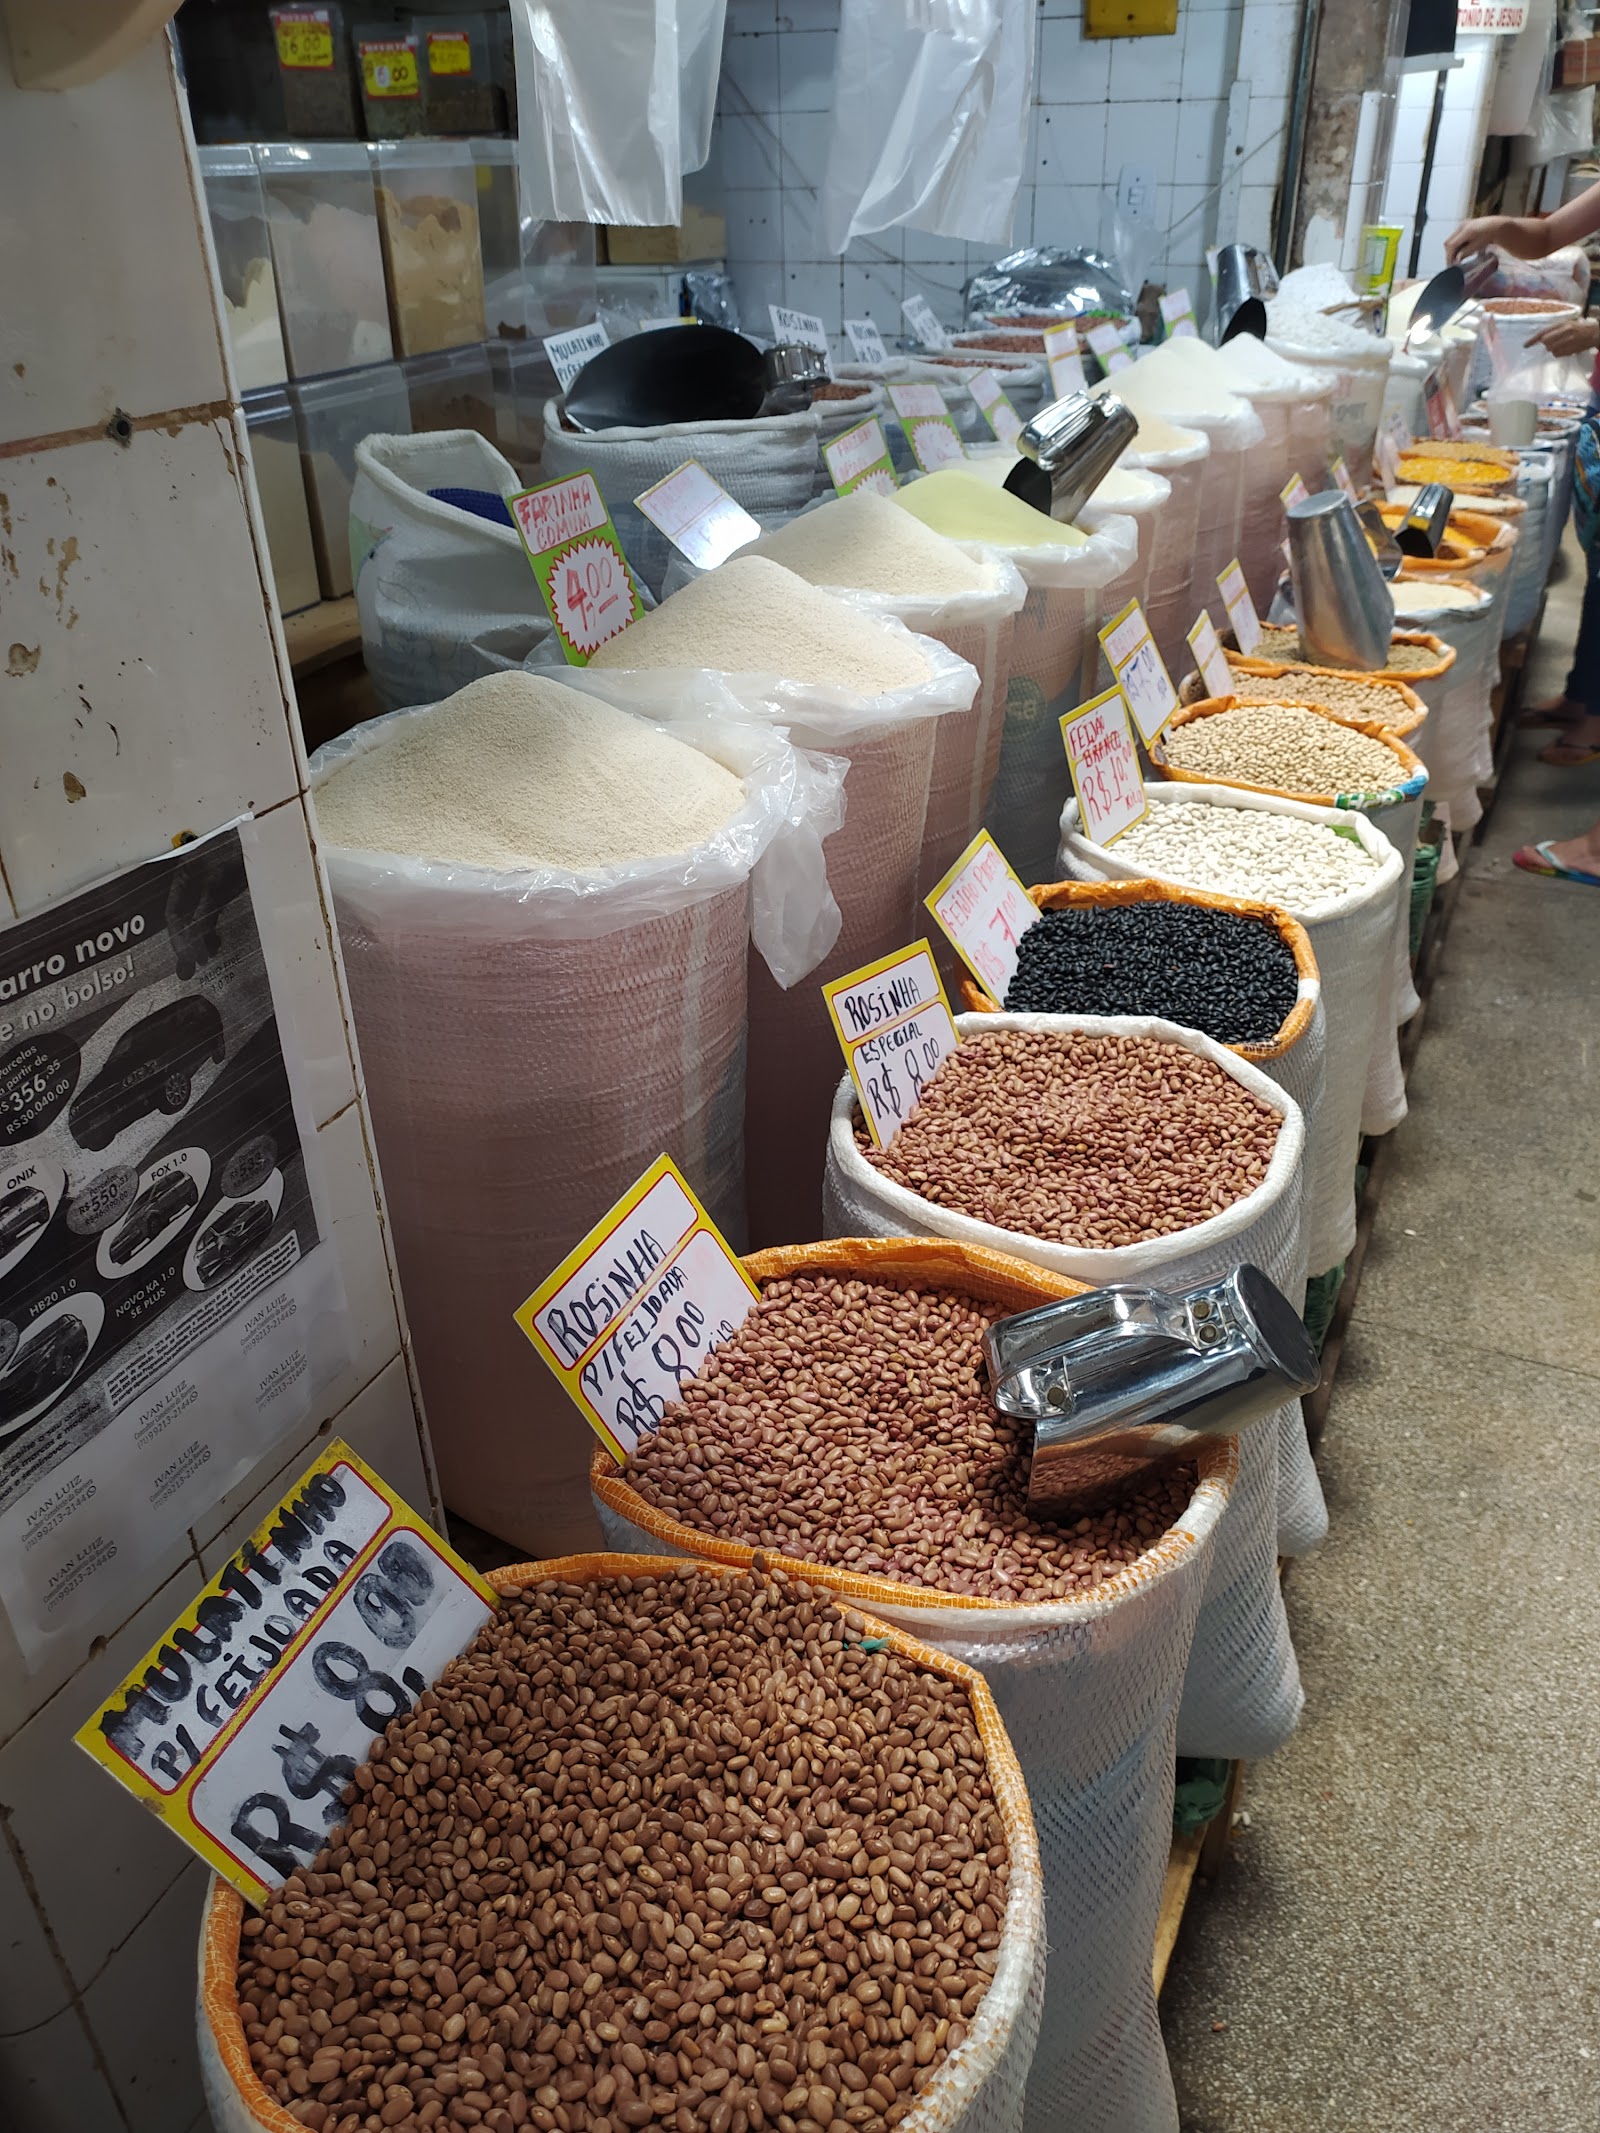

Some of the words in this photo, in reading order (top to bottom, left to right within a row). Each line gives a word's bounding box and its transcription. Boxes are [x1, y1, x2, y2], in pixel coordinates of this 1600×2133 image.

[1484, 8, 1495, 26] DE
[1496, 8, 1523, 27] JESUS
[517, 479, 592, 535] FARINHA
[536, 513, 592, 551] COMUM
[1082, 765, 1113, 823] R$
[75, 914, 145, 963] novo
[972, 939, 1006, 986] R$
[21, 1002, 56, 1030] no
[61, 954, 135, 1010] bolso!
[844, 974, 922, 1034] ROSINHA
[860, 1020, 924, 1065] ESPECIAL
[6, 1063, 32, 1091] partir
[34, 1053, 49, 1067] de
[866, 1061, 903, 1121] R$
[7, 1165, 37, 1190] ONIX
[150, 1162, 171, 1182] FOX
[173, 1152, 188, 1168] 1.0
[28, 1292, 59, 1318] HB20
[60, 1278, 77, 1296] 1.0
[115, 1290, 145, 1318] NOVO
[146, 1278, 160, 1293] KA
[161, 1266, 176, 1282] 1.0
[130, 1303, 143, 1319] SE
[143, 1287, 167, 1309] PLUS
[244, 1310, 264, 1332] IVAN
[265, 1293, 288, 1314] LUIZ
[547, 1228, 668, 1363] ROSINHA
[259, 1368, 280, 1391] IVAN
[280, 1349, 301, 1371] LUIZ
[139, 1400, 164, 1425] IVAN
[165, 1380, 188, 1403] LUIZ
[615, 1369, 666, 1438] R$
[153, 1462, 177, 1488] IVAN
[178, 1440, 201, 1465] LUIZ
[26, 1499, 53, 1527] IVAN
[55, 1474, 83, 1501] LUIZ
[47, 1560, 75, 1588] IVAN
[76, 1536, 104, 1561] LUIZ
[230, 1720, 359, 1879] R$
